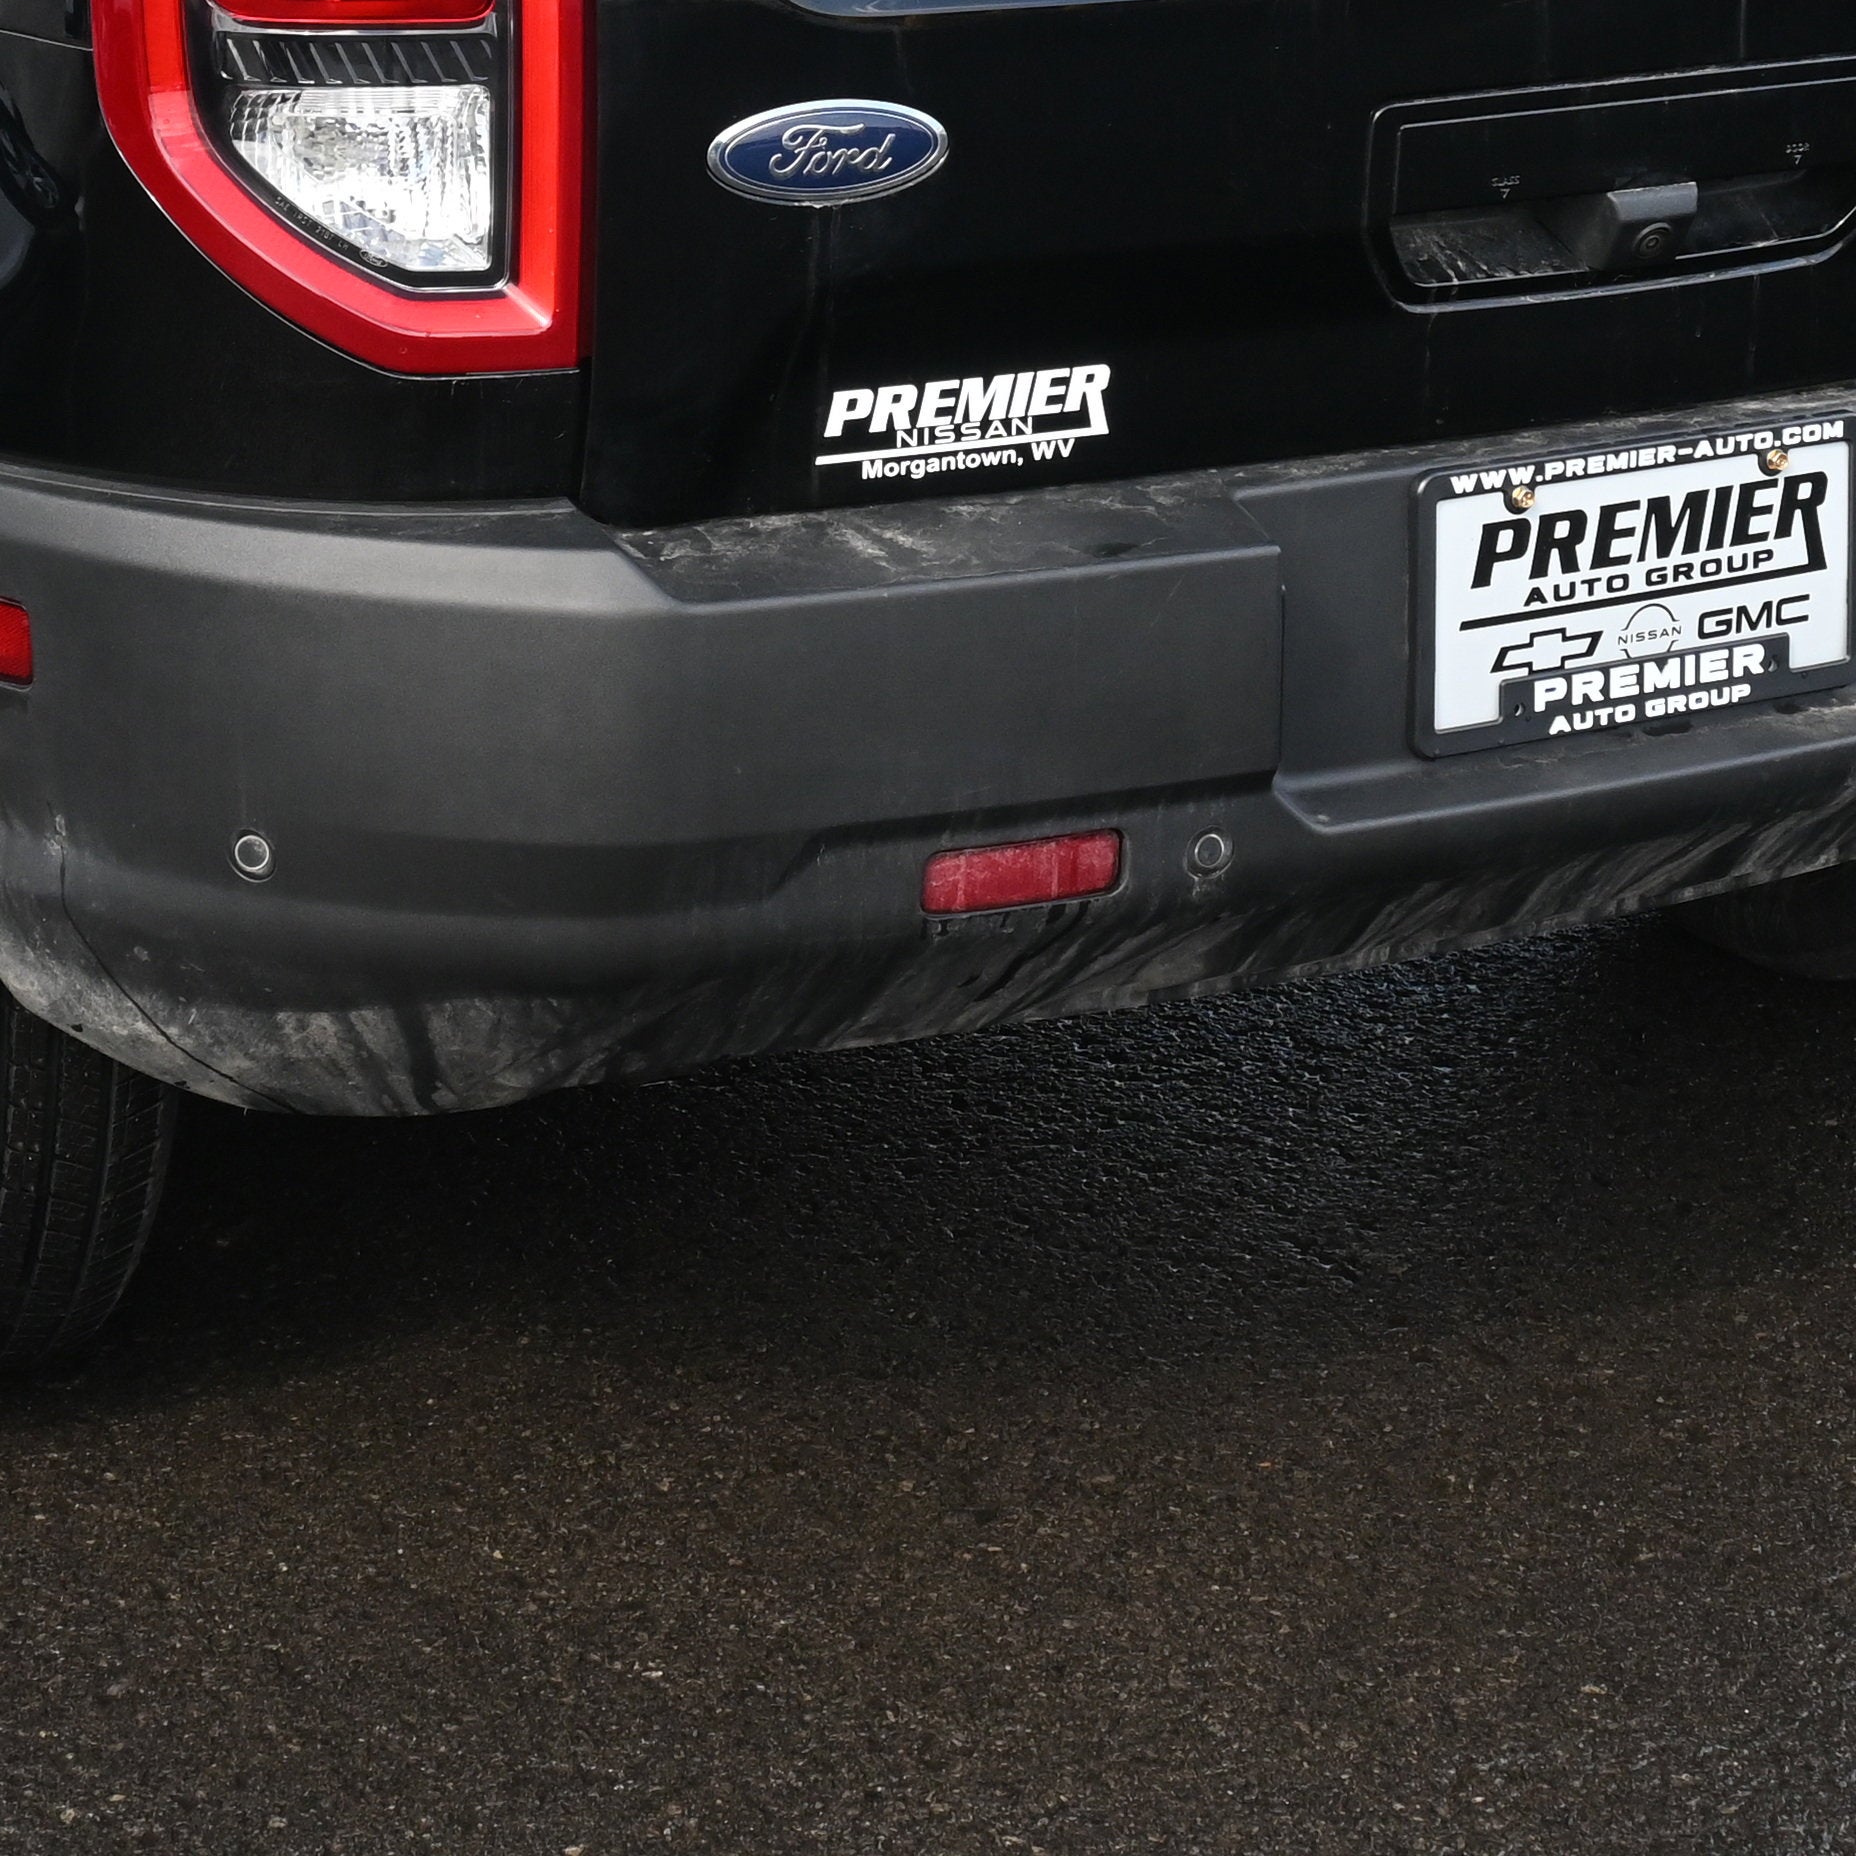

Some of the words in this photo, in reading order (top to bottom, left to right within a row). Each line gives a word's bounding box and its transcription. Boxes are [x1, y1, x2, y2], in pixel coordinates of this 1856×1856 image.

[768, 122, 897, 179] Ford
[824, 363, 1112, 438] PREMIER
[861, 449, 1025, 480] Morgantown,
[1031, 438, 1076, 462] WV
[897, 416, 1033, 448] NISSAN
[1450, 420, 1845, 495] WWW.PREMIER-AUTO.COM
[1470, 470, 1828, 590] PREMIER
[1524, 573, 1630, 607] AUTO
[1644, 548, 1774, 588] GROUP
[1617, 624, 1682, 646] NISSAN
[1697, 593, 1811, 641] GMC
[1534, 643, 1766, 712] PREMIER
[1548, 702, 1636, 735] AUTO
[1644, 683, 1752, 719] GROUP
